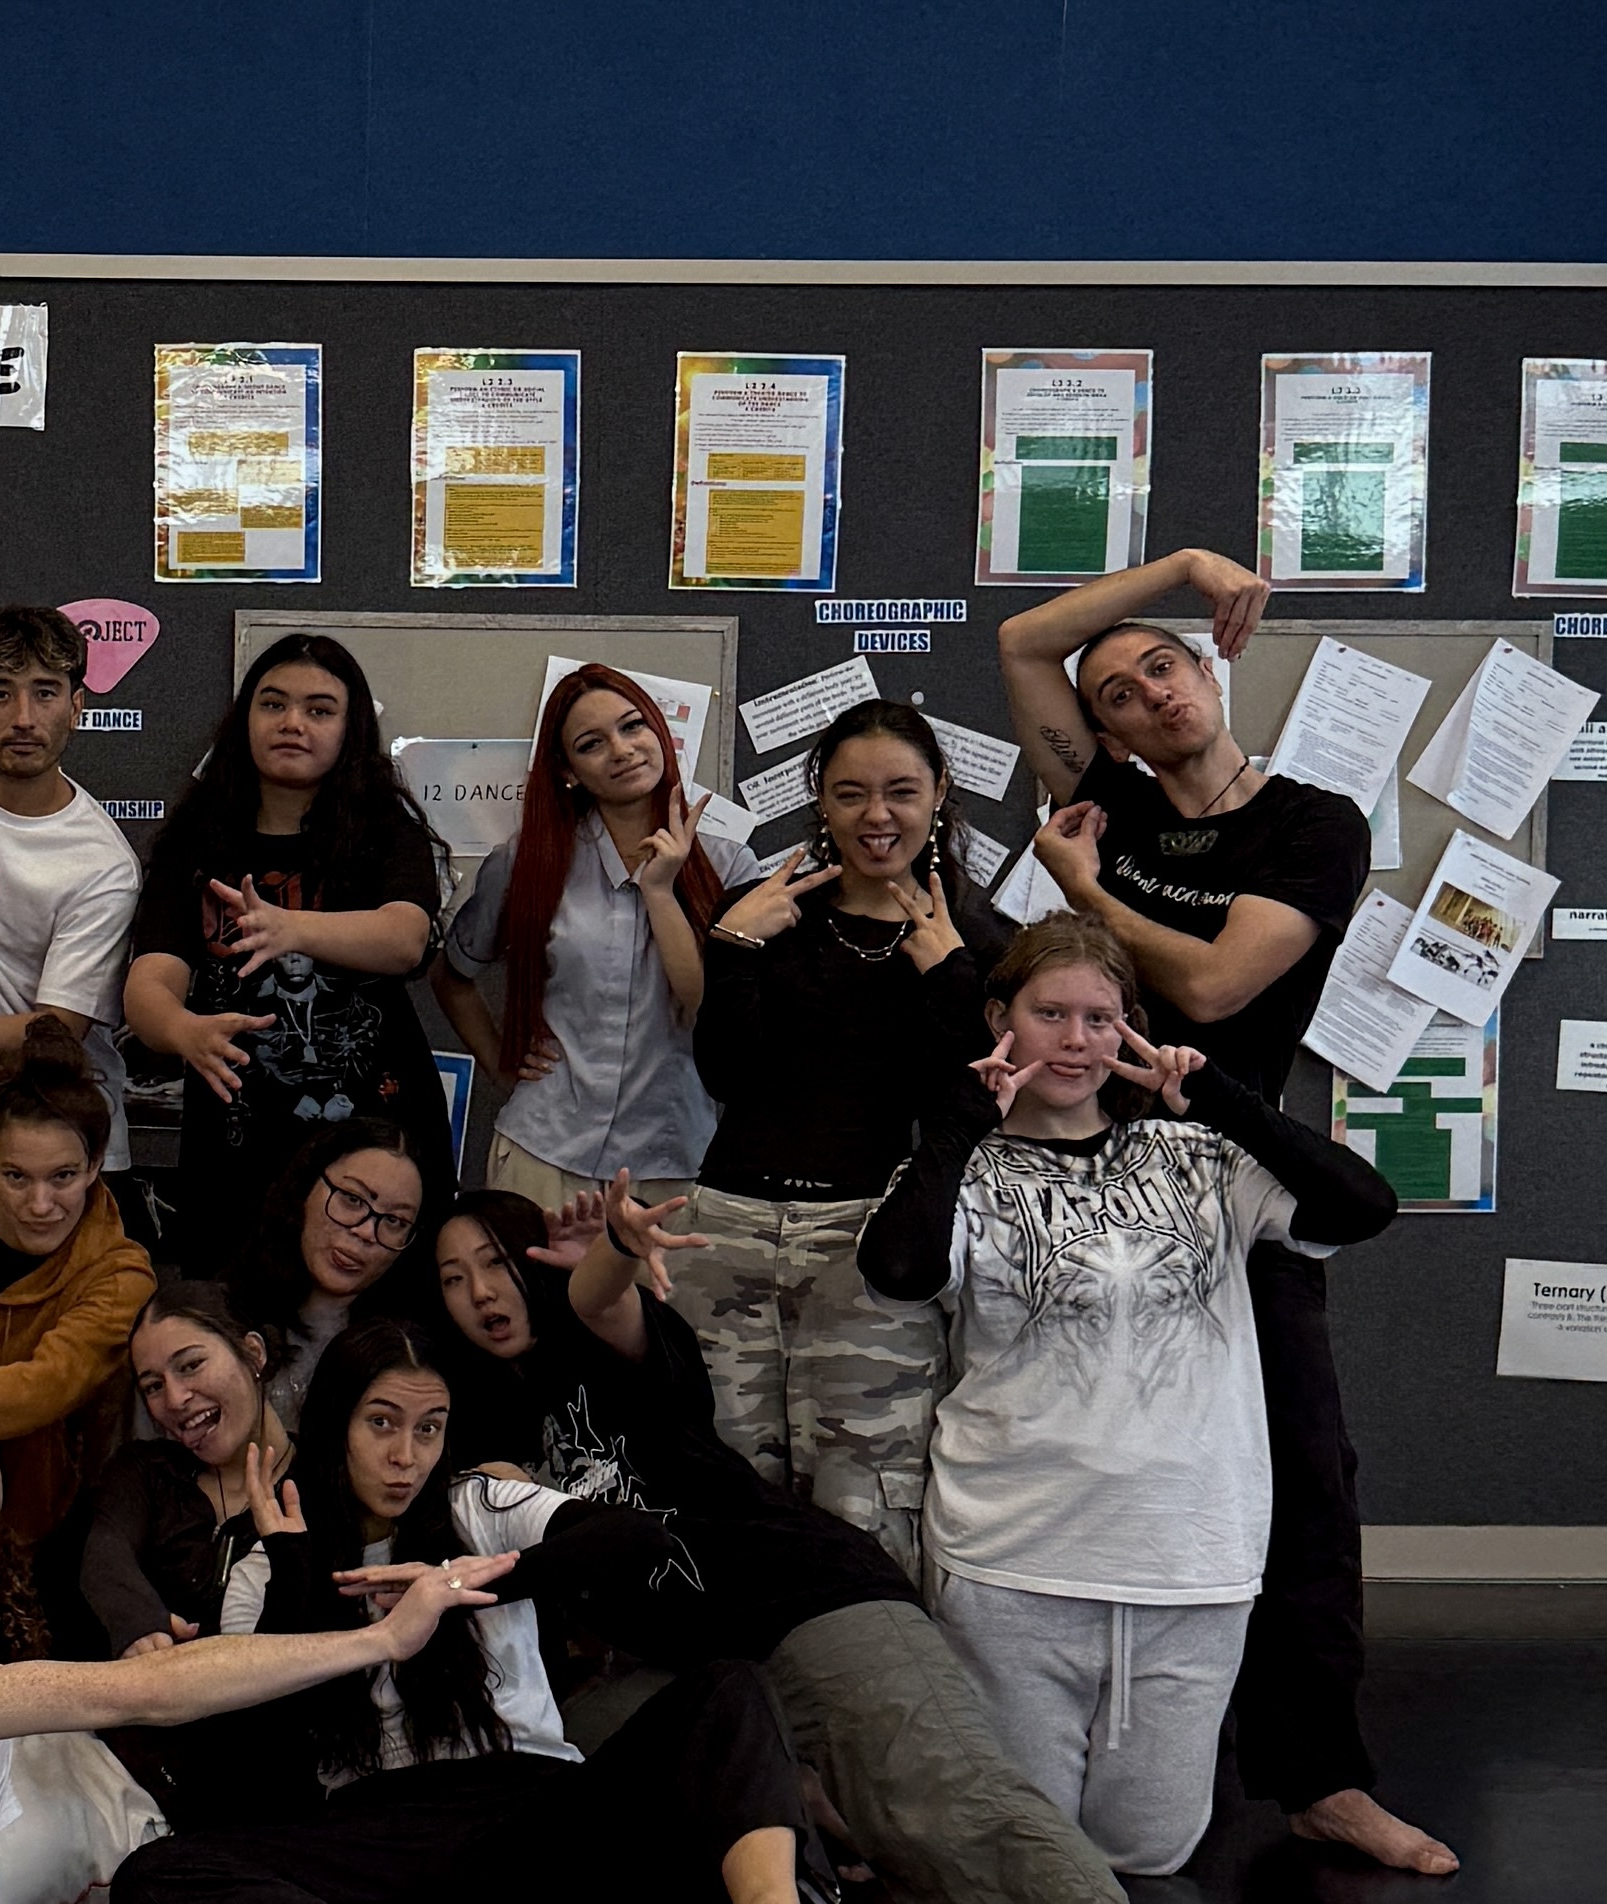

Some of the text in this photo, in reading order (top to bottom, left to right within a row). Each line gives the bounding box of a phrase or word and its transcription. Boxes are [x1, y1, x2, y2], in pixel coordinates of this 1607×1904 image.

[818, 601, 964, 621] CHOREOGRAPHIC
[857, 633, 929, 651] DEVICES
[92, 712, 140, 728] DANCE
[424, 784, 525, 801] 12 DANCE
[1533, 1282, 1596, 1303] Ternary
